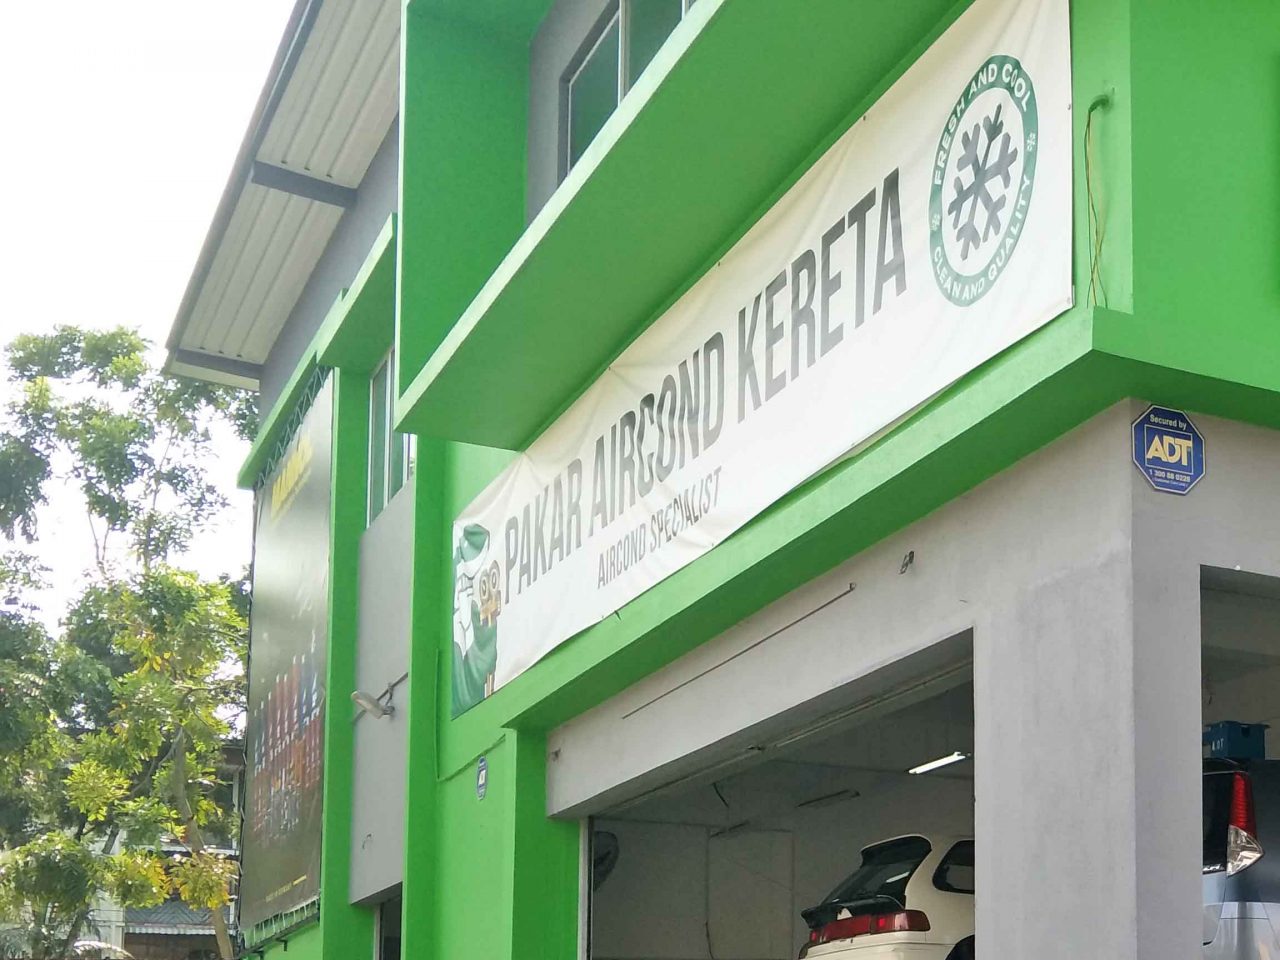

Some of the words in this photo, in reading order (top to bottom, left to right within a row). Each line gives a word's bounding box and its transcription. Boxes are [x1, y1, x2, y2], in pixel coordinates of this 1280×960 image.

[935, 96, 966, 185] FRESH
[967, 63, 998, 98] AND
[1002, 63, 1031, 112] COOL
[933, 246, 962, 300] CLEAN
[961, 279, 985, 300] AND
[987, 176, 1031, 281] QUALITY
[504, 458, 582, 604] PAKAR
[587, 331, 725, 538] AIRCOND
[737, 166, 907, 424] KERETA
[1149, 414, 1177, 427] Secured
[1178, 421, 1187, 430] by
[1146, 434, 1193, 466] ADT
[597, 523, 646, 589] AIRCOND
[650, 465, 722, 552] SPECIALIST
